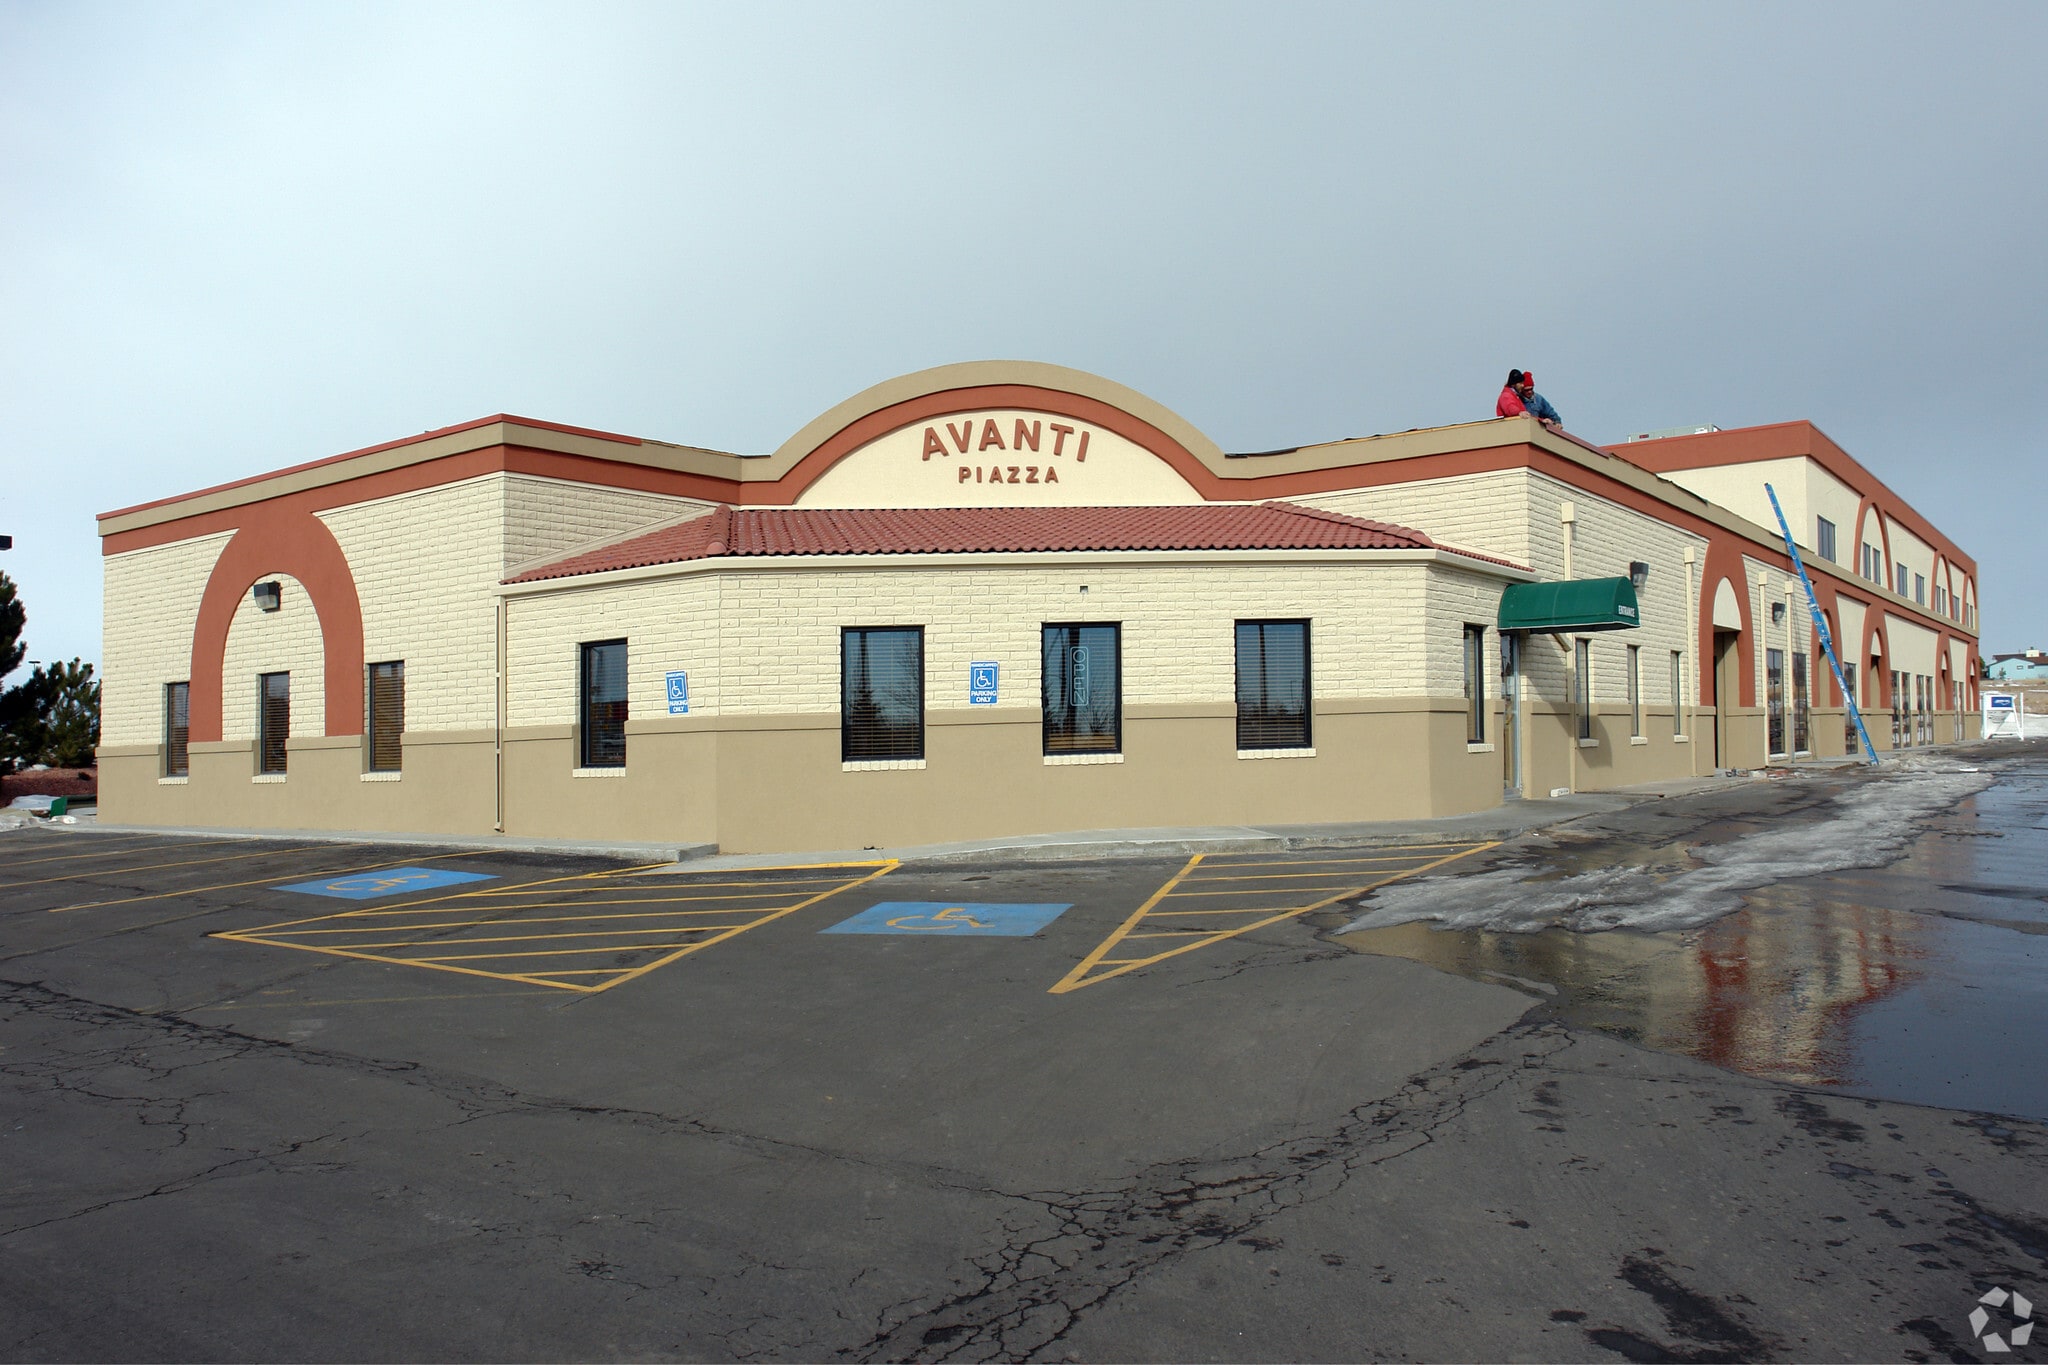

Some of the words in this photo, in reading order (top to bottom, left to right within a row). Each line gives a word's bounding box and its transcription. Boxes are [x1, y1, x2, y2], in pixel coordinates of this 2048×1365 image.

[922, 418, 1090, 462] AVANTI
[959, 466, 1059, 484] PIAZZA
[1618, 605, 1635, 618] ENTRANCE
[1073, 649, 1086, 703] OPEN
